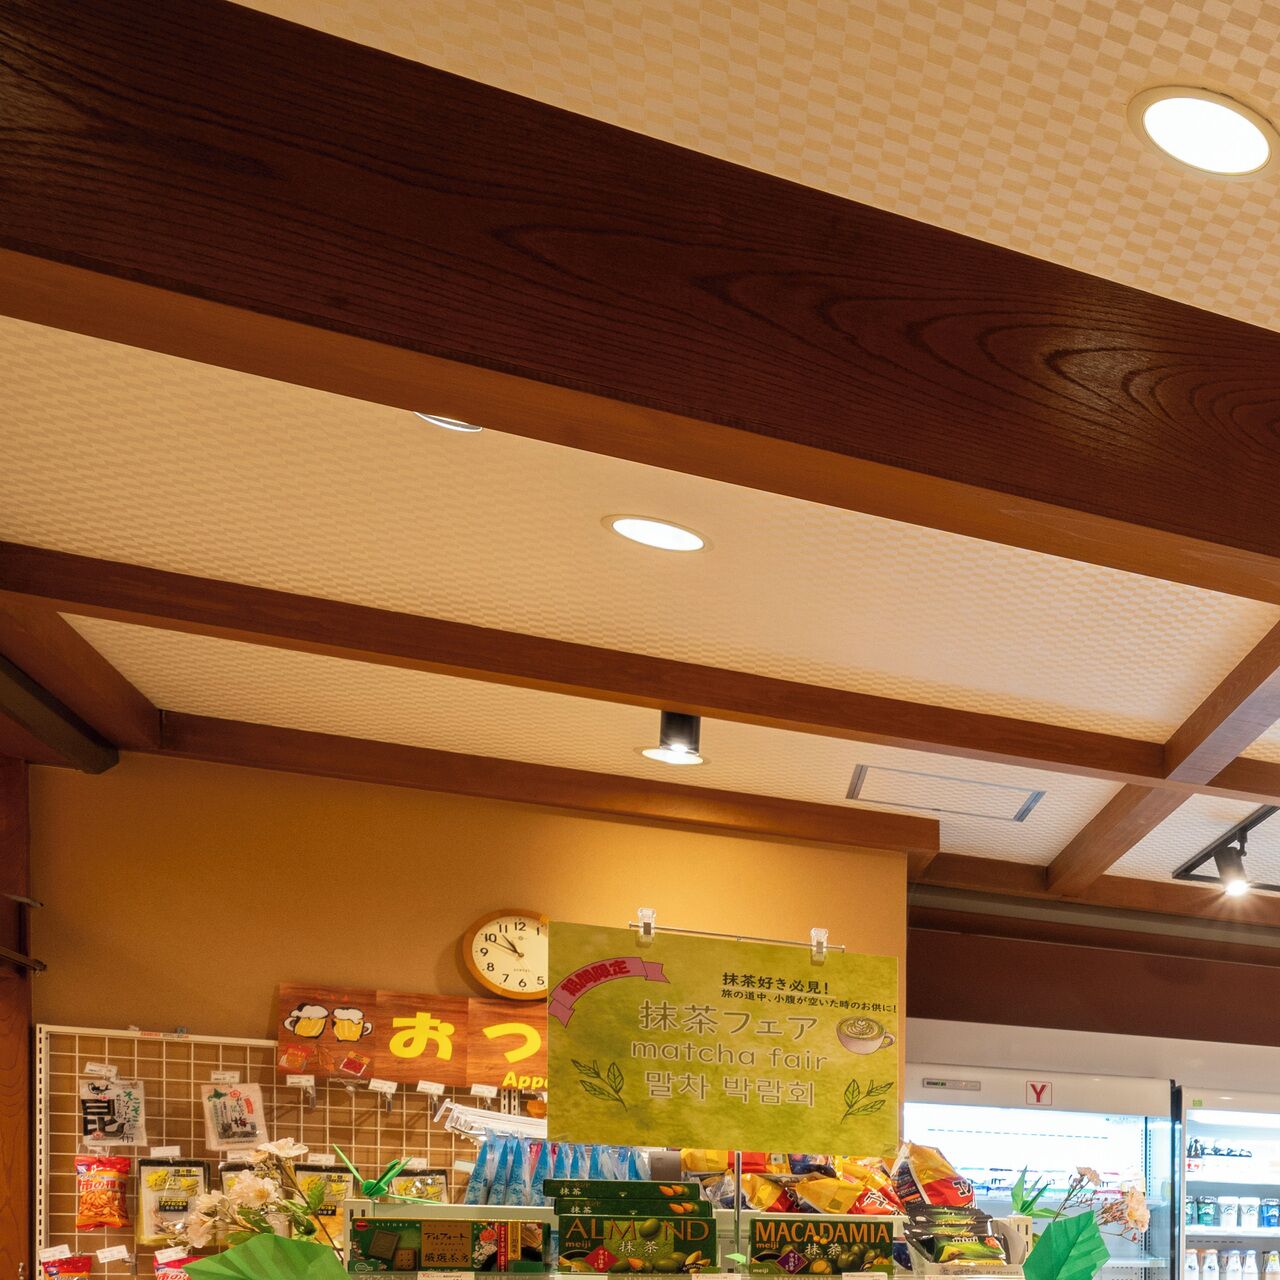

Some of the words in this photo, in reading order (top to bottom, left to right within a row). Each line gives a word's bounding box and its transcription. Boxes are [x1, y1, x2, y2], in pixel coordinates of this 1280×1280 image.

[499, 924, 508, 933] 11
[515, 922, 526, 931] 12
[536, 927, 541, 935] 1
[484, 933, 497, 943] 10
[480, 947, 488, 957] 9
[487, 962, 495, 972] 8
[502, 974, 509, 983] 7
[518, 978, 527, 988] 6
[537, 976, 545, 985] 5
[560, 960, 632, 997] 期間限定
[638, 1000, 819, 1041] 抹茶フェア
[389, 1011, 541, 1064] おつ
[631, 1040, 755, 1066] matcha
[768, 1047, 829, 1071] fair
[645, 1071, 709, 1100] 말차
[723, 1077, 815, 1108] 박람회
[1031, 1084, 1048, 1102] Y
[424, 1231, 470, 1242] アルフォート
[755, 1221, 890, 1243] MACADAMIA
[565, 1241, 592, 1249] meiji
[619, 1241, 659, 1253] 抹茶
[756, 1241, 780, 1250] meiji
[805, 1243, 842, 1256] 抹茶
